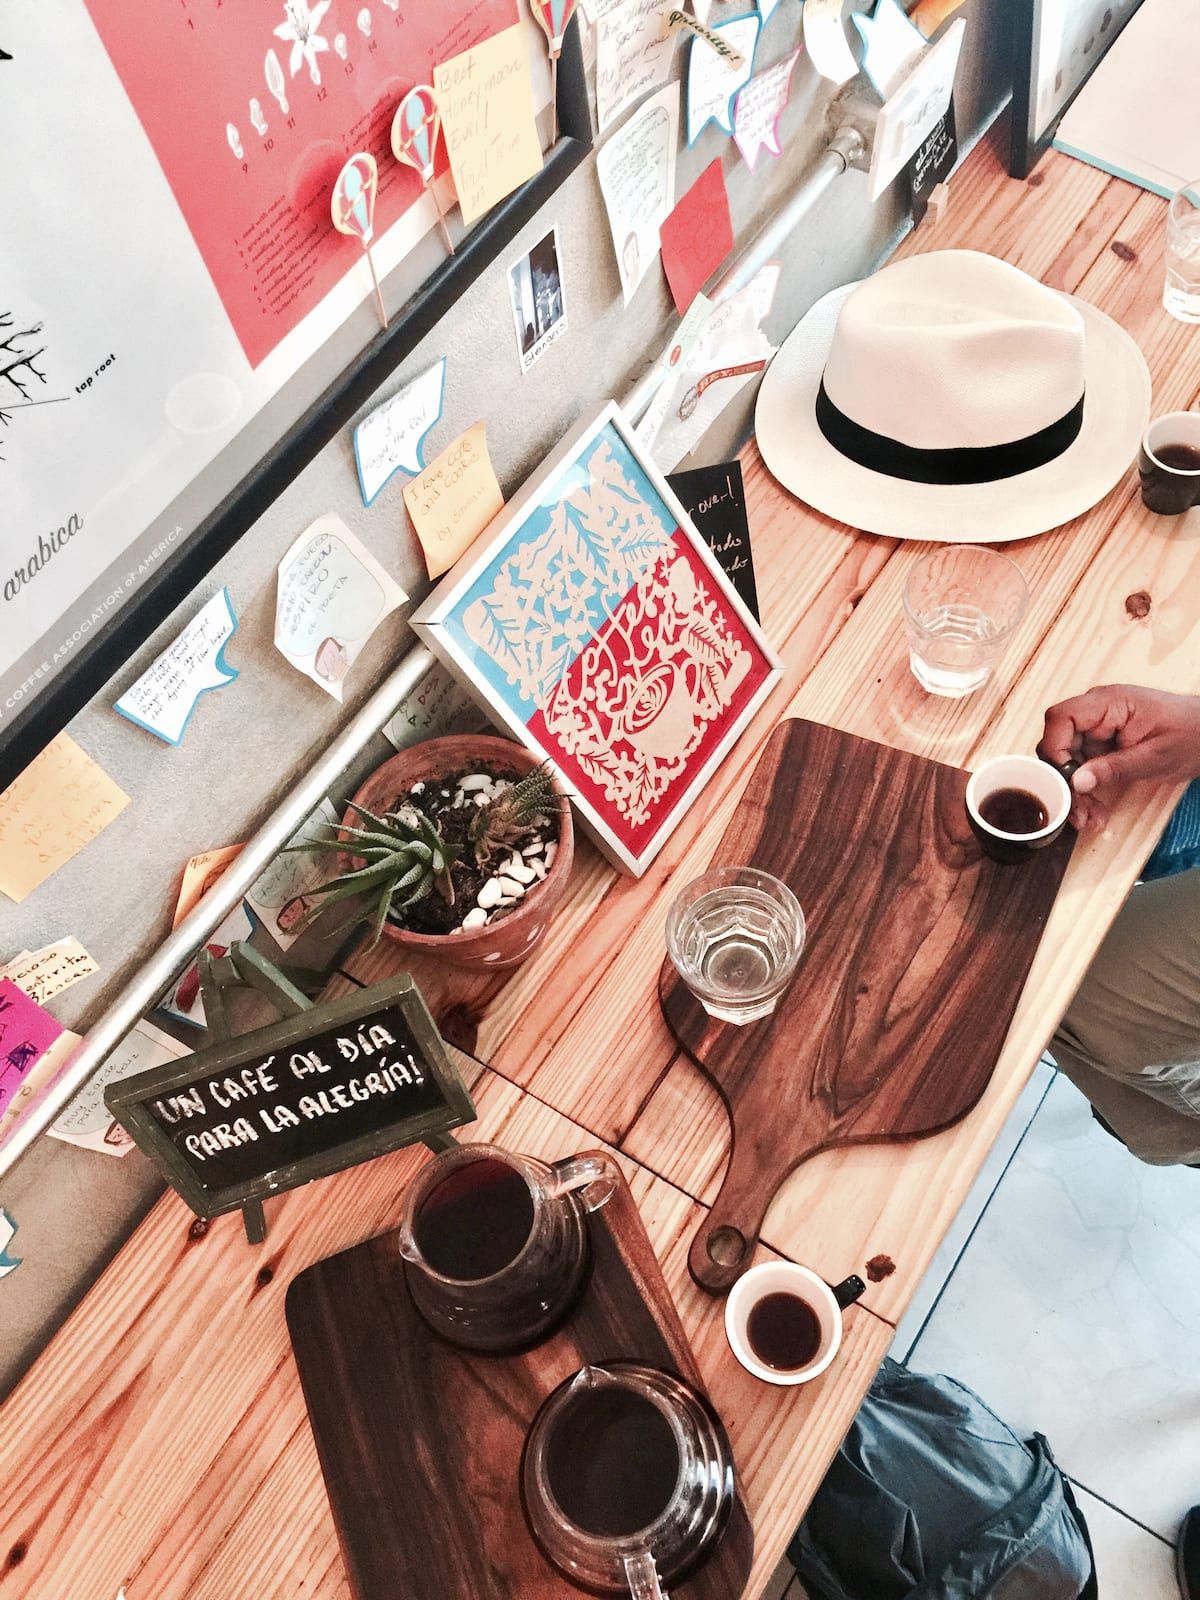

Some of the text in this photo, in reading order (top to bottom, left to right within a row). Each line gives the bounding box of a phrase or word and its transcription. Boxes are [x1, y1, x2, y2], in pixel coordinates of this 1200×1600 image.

[395, 14, 405, 27] 15
[367, 41, 378, 53] 14
[344, 63, 354, 75] 13
[317, 88, 328, 102] 12
[287, 118, 296, 129] 11
[264, 140, 274, 151] 10
[242, 165, 248, 174] 9
[75, 354, 117, 394] tap root
[3, 511, 84, 602] arabica
[6, 659, 51, 708] COFFEE
[52, 587, 124, 662] ASSOCIATION
[138, 525, 183, 575] AMERICA
[155, 1086, 206, 1124] UN
[209, 1055, 279, 1109] CAFÉ
[289, 1051, 331, 1081] AL
[185, 1055, 425, 1161] PARA LA ALEGRÍA!
